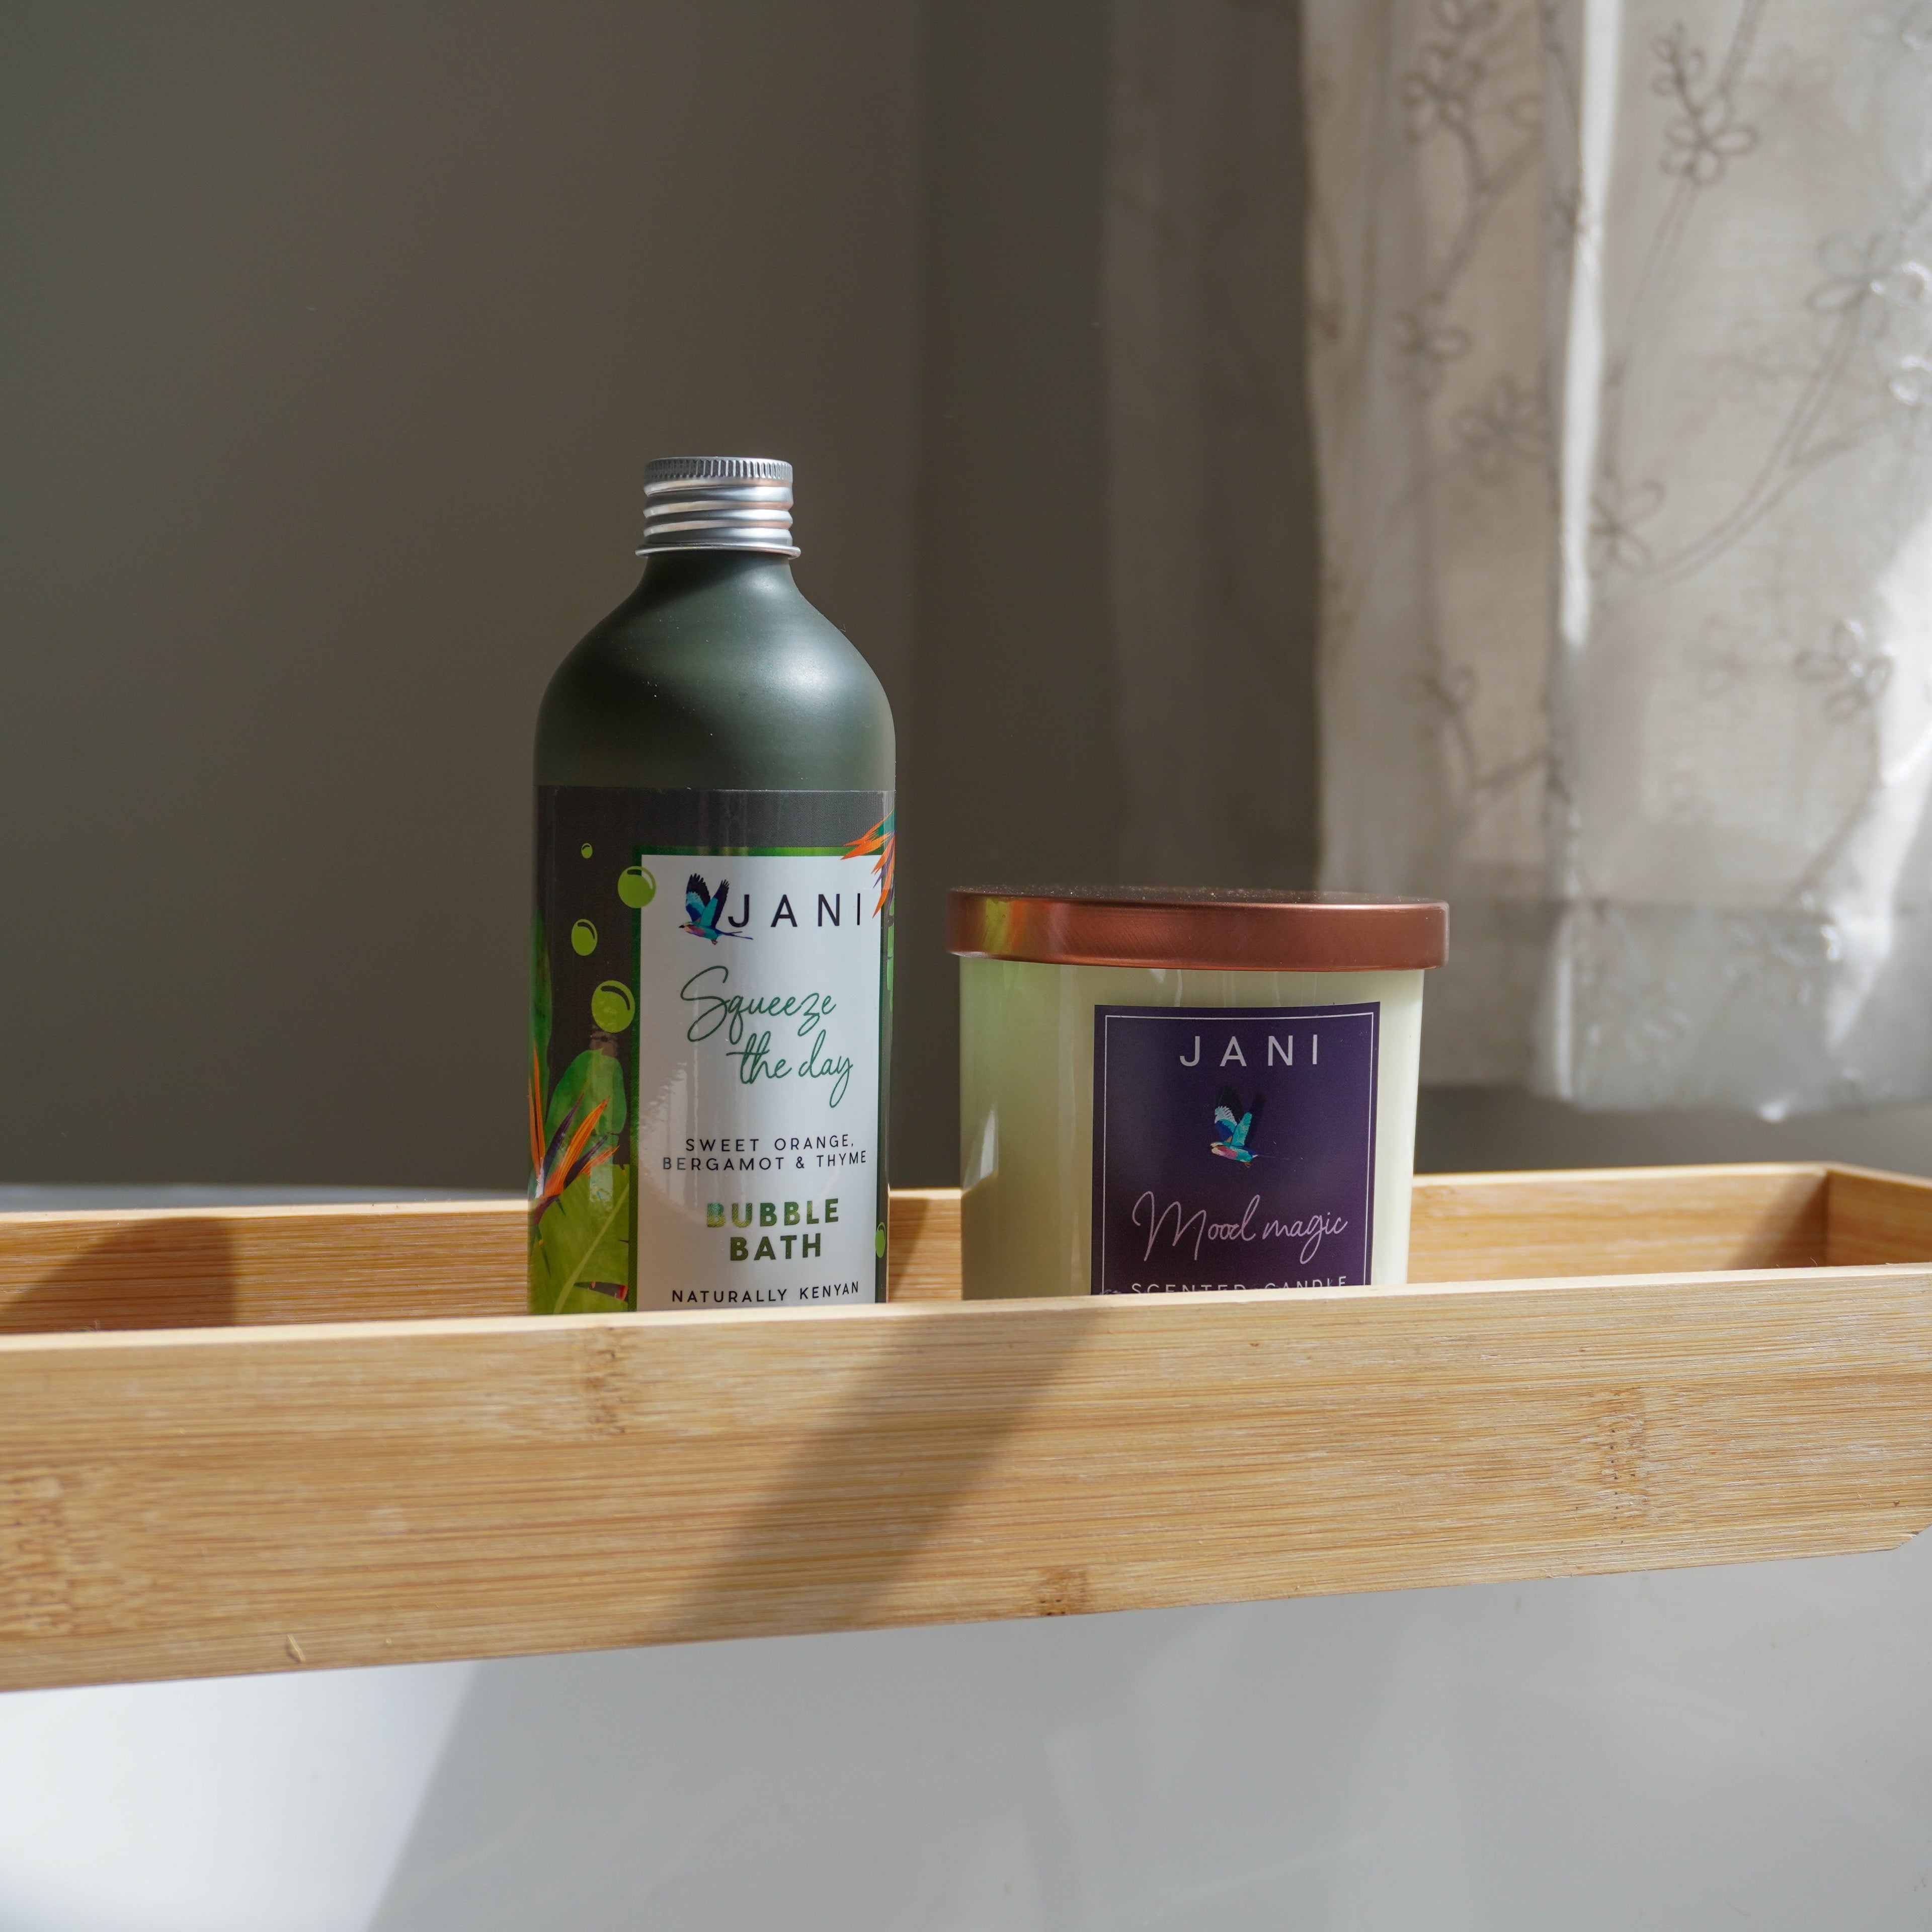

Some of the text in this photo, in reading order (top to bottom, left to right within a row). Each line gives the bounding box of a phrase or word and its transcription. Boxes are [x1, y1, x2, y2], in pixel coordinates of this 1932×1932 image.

[728, 893, 860, 928] JANI
[680, 965, 836, 1045] Squeeze
[1179, 1034, 1318, 1067] JANI
[726, 1029, 853, 1108] the day
[685, 1134, 854, 1152] SWEET ORANGE,
[663, 1150, 867, 1171] BERGAMOT & THYME
[706, 1198, 839, 1228] BUBBLE
[1132, 1190, 1348, 1264] Mood magic
[730, 1233, 821, 1261] BATH
[672, 1281, 859, 1303] NATURALLY KENYAN
